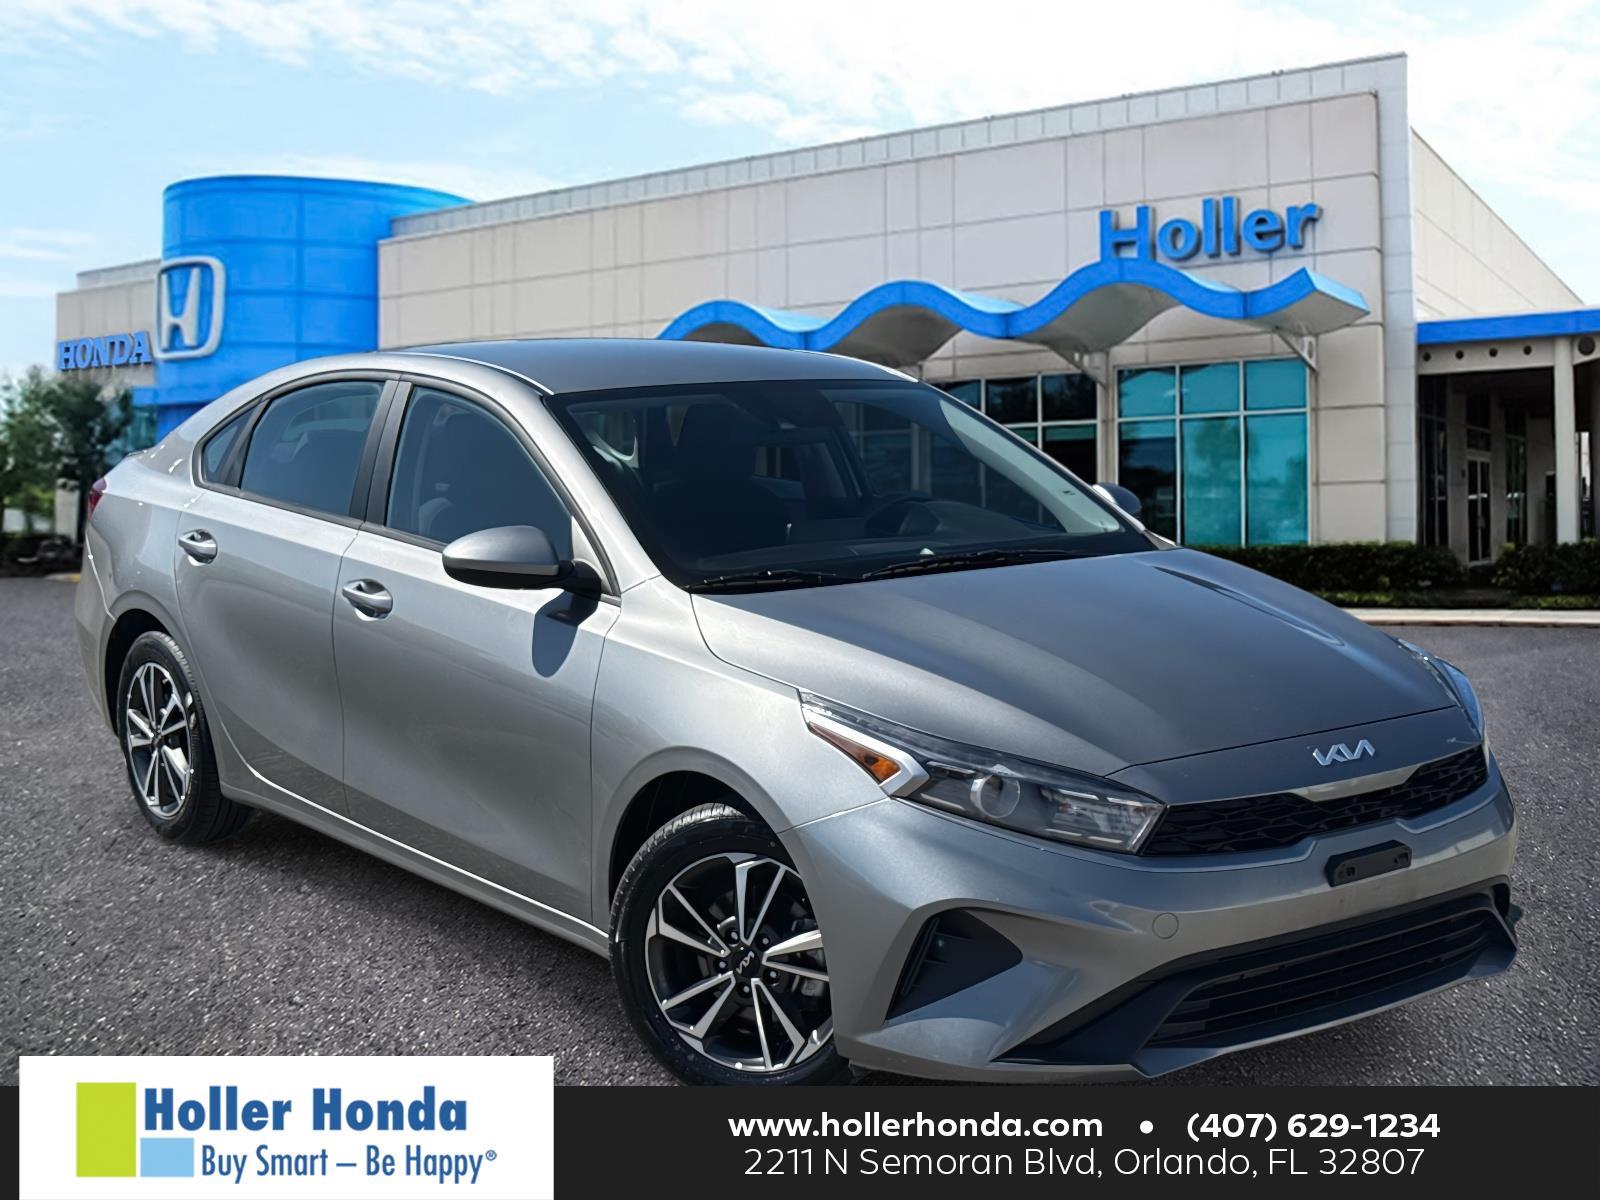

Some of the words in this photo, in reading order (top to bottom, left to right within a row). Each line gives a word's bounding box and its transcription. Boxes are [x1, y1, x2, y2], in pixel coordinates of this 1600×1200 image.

[1099, 196, 1321, 261] Holler
[57, 331, 152, 370] HONDA
[1312, 739, 1376, 766] KIA
